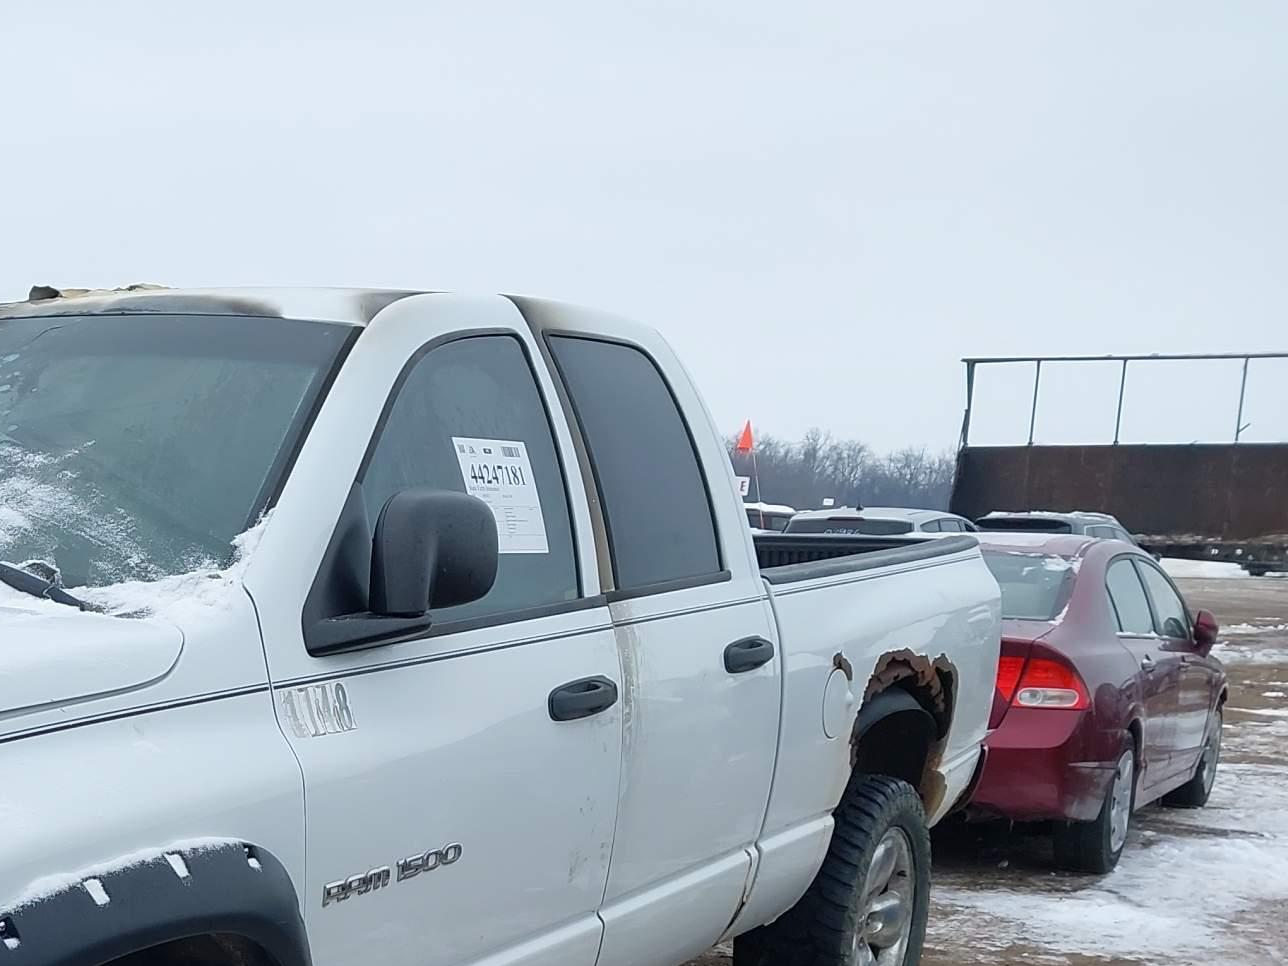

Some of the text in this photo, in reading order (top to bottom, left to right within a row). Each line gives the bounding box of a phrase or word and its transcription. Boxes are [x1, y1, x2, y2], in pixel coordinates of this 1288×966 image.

[470, 464, 526, 486] 44247181
[322, 842, 462, 908] RAM 1500
